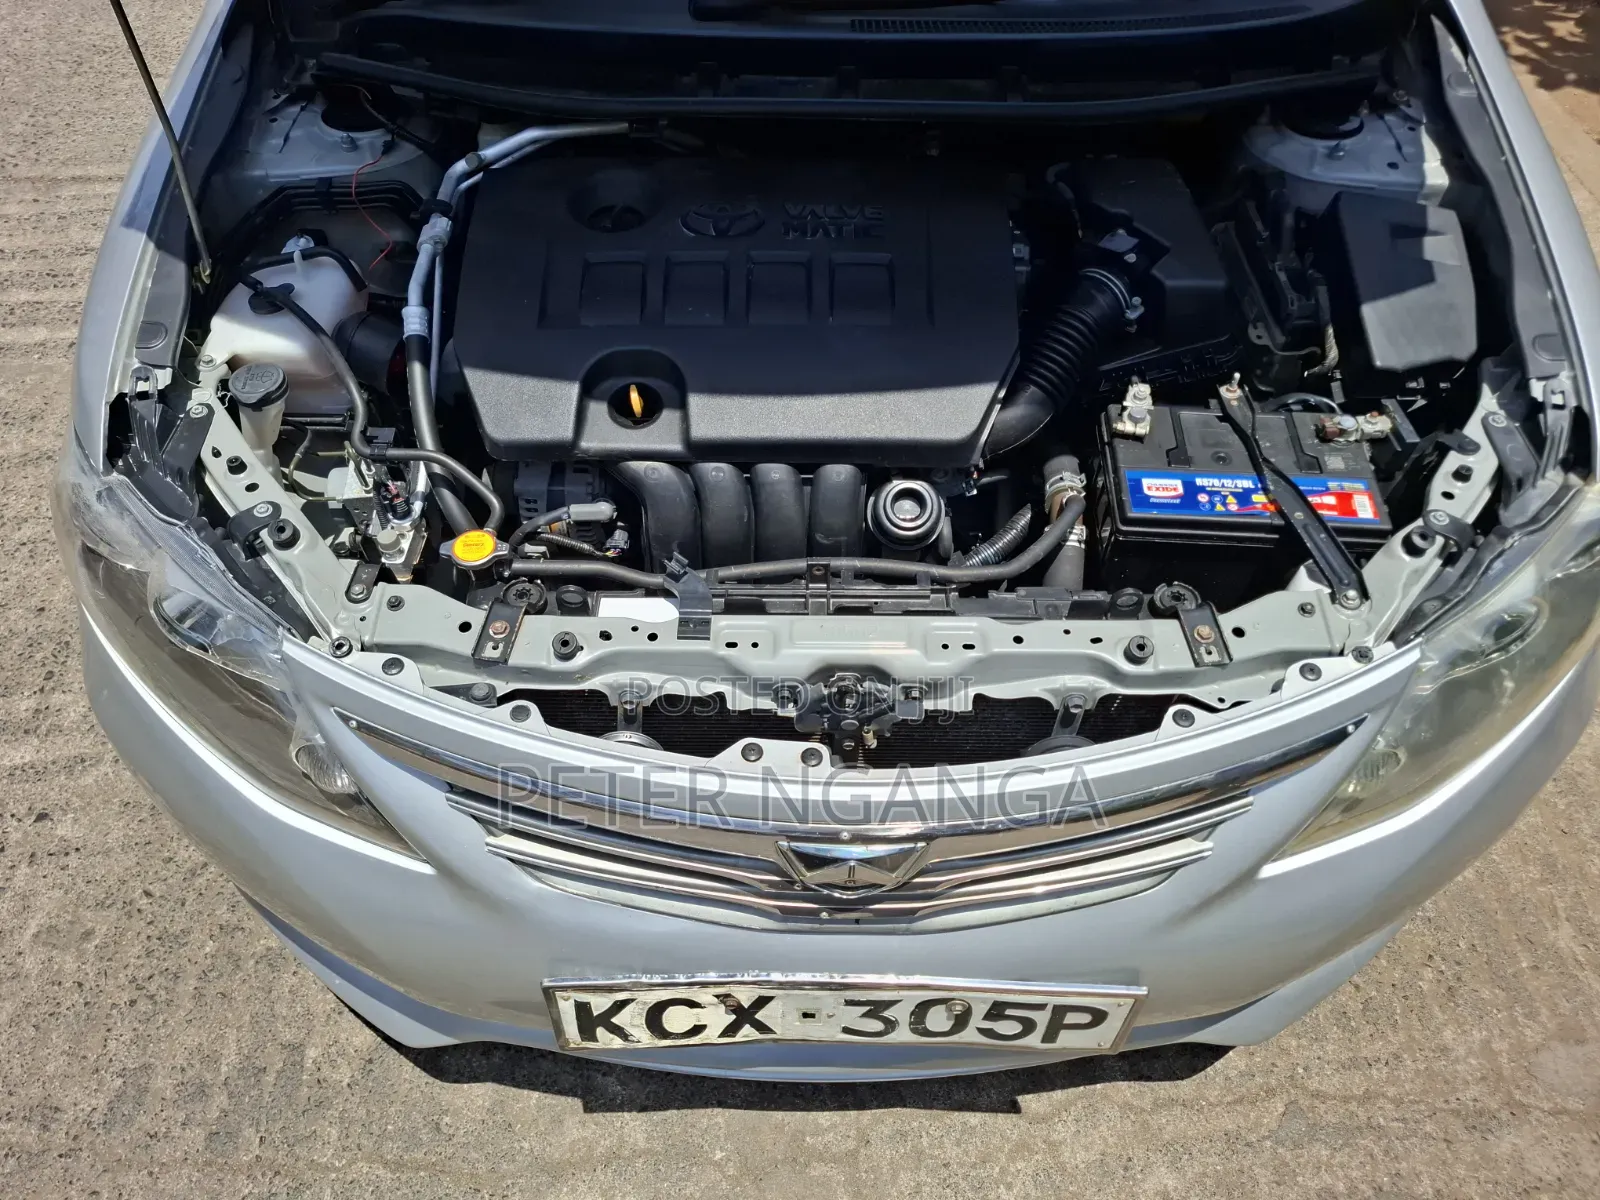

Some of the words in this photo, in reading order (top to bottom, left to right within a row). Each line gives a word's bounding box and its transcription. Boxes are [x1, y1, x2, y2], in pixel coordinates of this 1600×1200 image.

[783, 202, 883, 221] VALVE
[1146, 485, 1180, 493] EXIDE
[573, 993, 778, 1043] KCX
[841, 997, 1109, 1044] 305P
